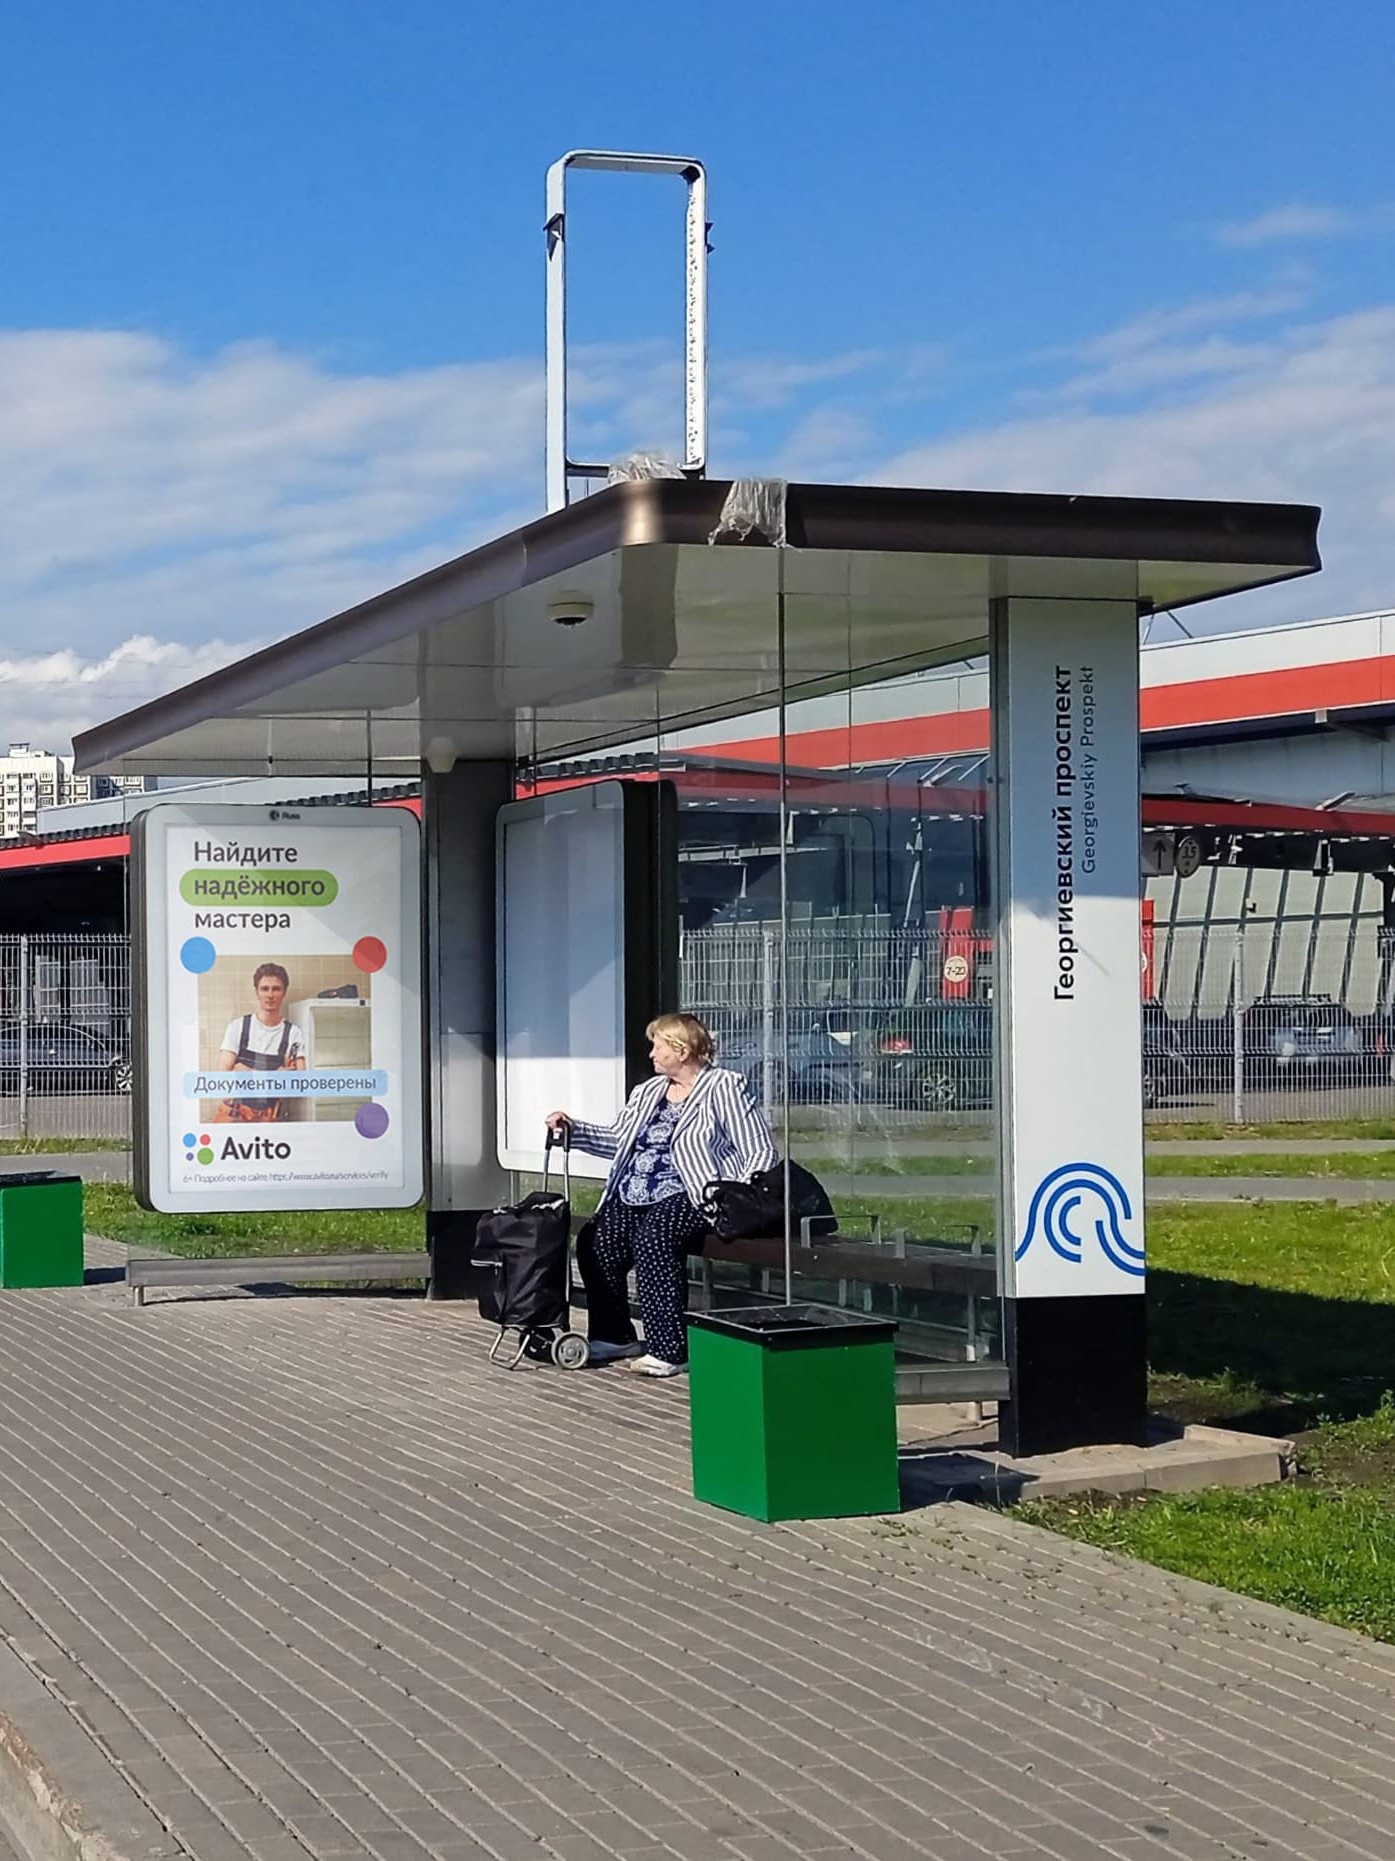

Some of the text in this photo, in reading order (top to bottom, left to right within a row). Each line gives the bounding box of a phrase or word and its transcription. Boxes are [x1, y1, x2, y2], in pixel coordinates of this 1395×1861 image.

[1079, 666, 1098, 874] Georgievskiy Prospekt
[1052, 665, 1079, 1000] Георгиевский проспект
[194, 841, 298, 867] Найдите
[194, 874, 326, 900] надёжного
[195, 912, 292, 933] мастера
[194, 1076, 377, 1094] Документы проверены
[220, 1136, 291, 1161] Avito
